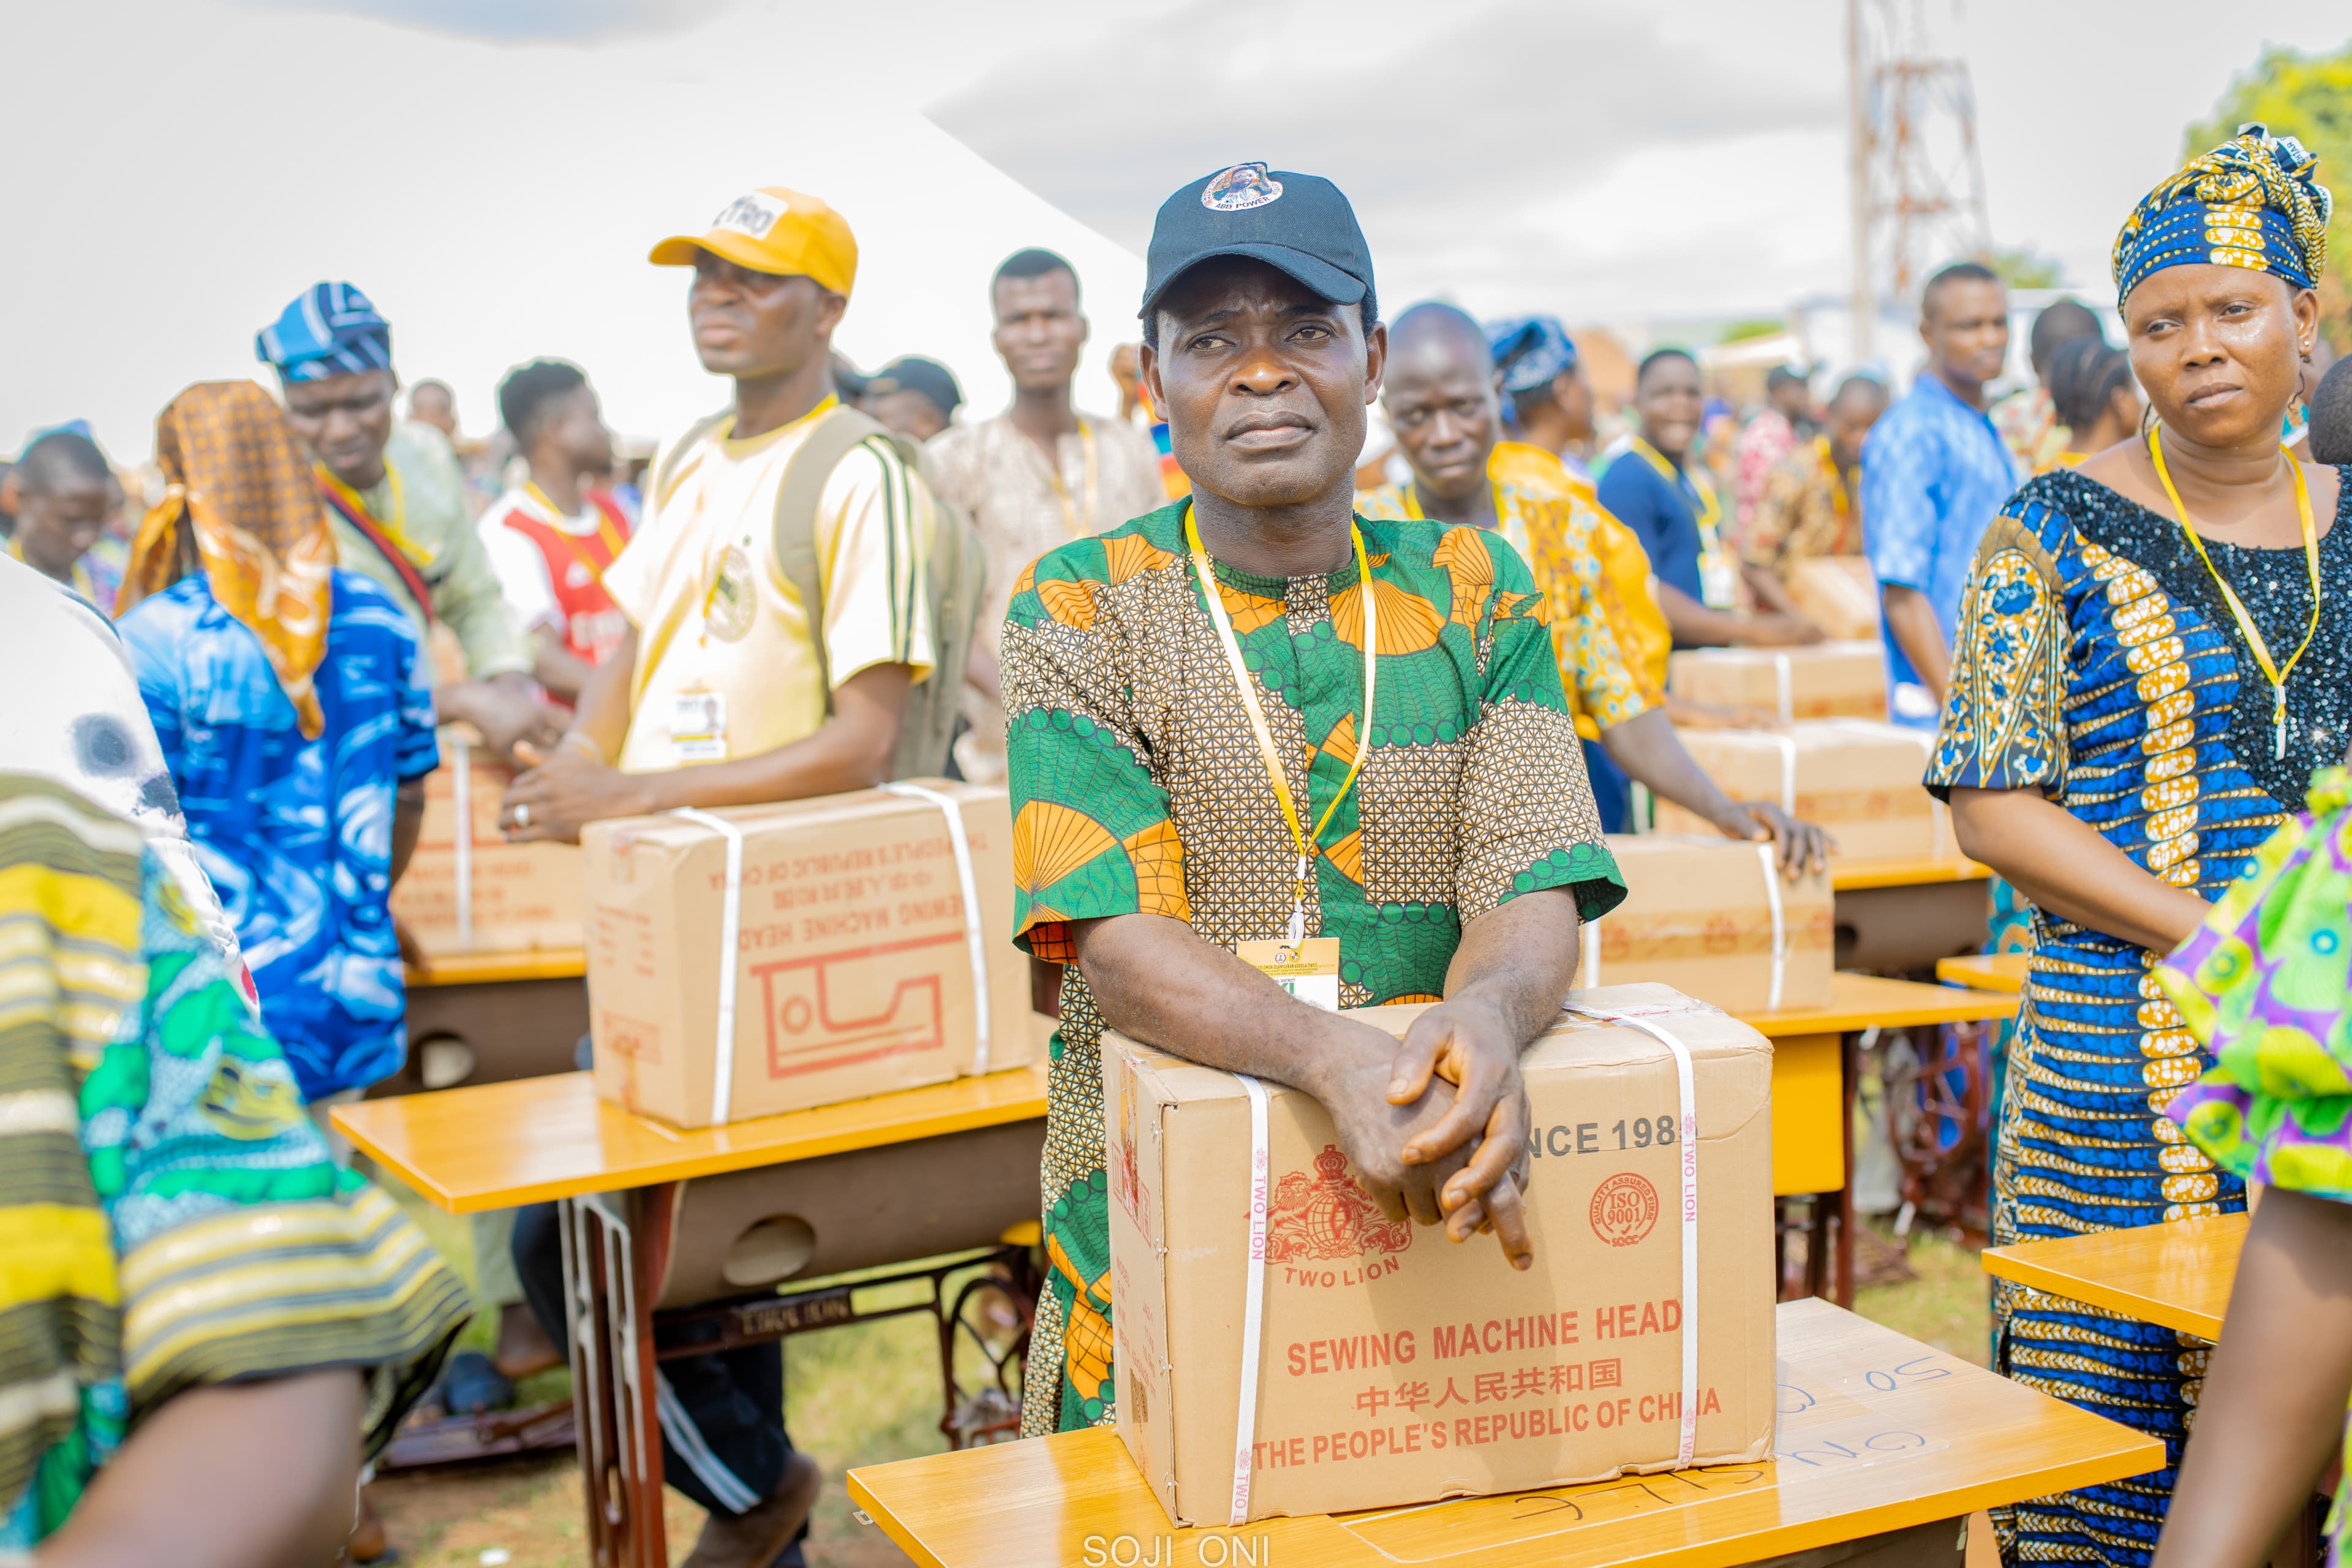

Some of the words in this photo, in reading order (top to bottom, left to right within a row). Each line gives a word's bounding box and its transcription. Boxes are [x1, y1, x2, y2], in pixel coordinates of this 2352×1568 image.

[1235, 196, 1270, 209] POWER
[737, 922, 793, 951] HEAD
[803, 907, 889, 942] MACHINE
[1529, 1122, 1599, 1158] NCE
[1612, 1115, 1698, 1152] 198
[1684, 1142, 1695, 1177] TWO
[1254, 1176, 1266, 1214] TWO
[1593, 1184, 1610, 1225] QUALITY
[1612, 1177, 1651, 1196] ASSURED
[1608, 1191, 1640, 1209] ISO
[1685, 1184, 1696, 1223] LION
[1607, 1207, 1640, 1226] 9001
[1251, 1221, 1265, 1260] LION
[1284, 1267, 1335, 1287] TWO
[1343, 1256, 1400, 1287] LION
[1287, 1330, 1416, 1377] SEWING
[1433, 1311, 1579, 1360] MACHINE
[1596, 1298, 1682, 1340] HEAD
[1356, 1357, 1622, 1417] 中华人民共和国
[1253, 1437, 1305, 1470] THE
[1313, 1421, 1447, 1463] PEOPLE'S
[1455, 1403, 1589, 1446] REPUBLIC
[1596, 1398, 1632, 1428] OF
[1680, 1434, 1695, 1465] TWO
[1234, 1474, 1249, 1510] TWO
